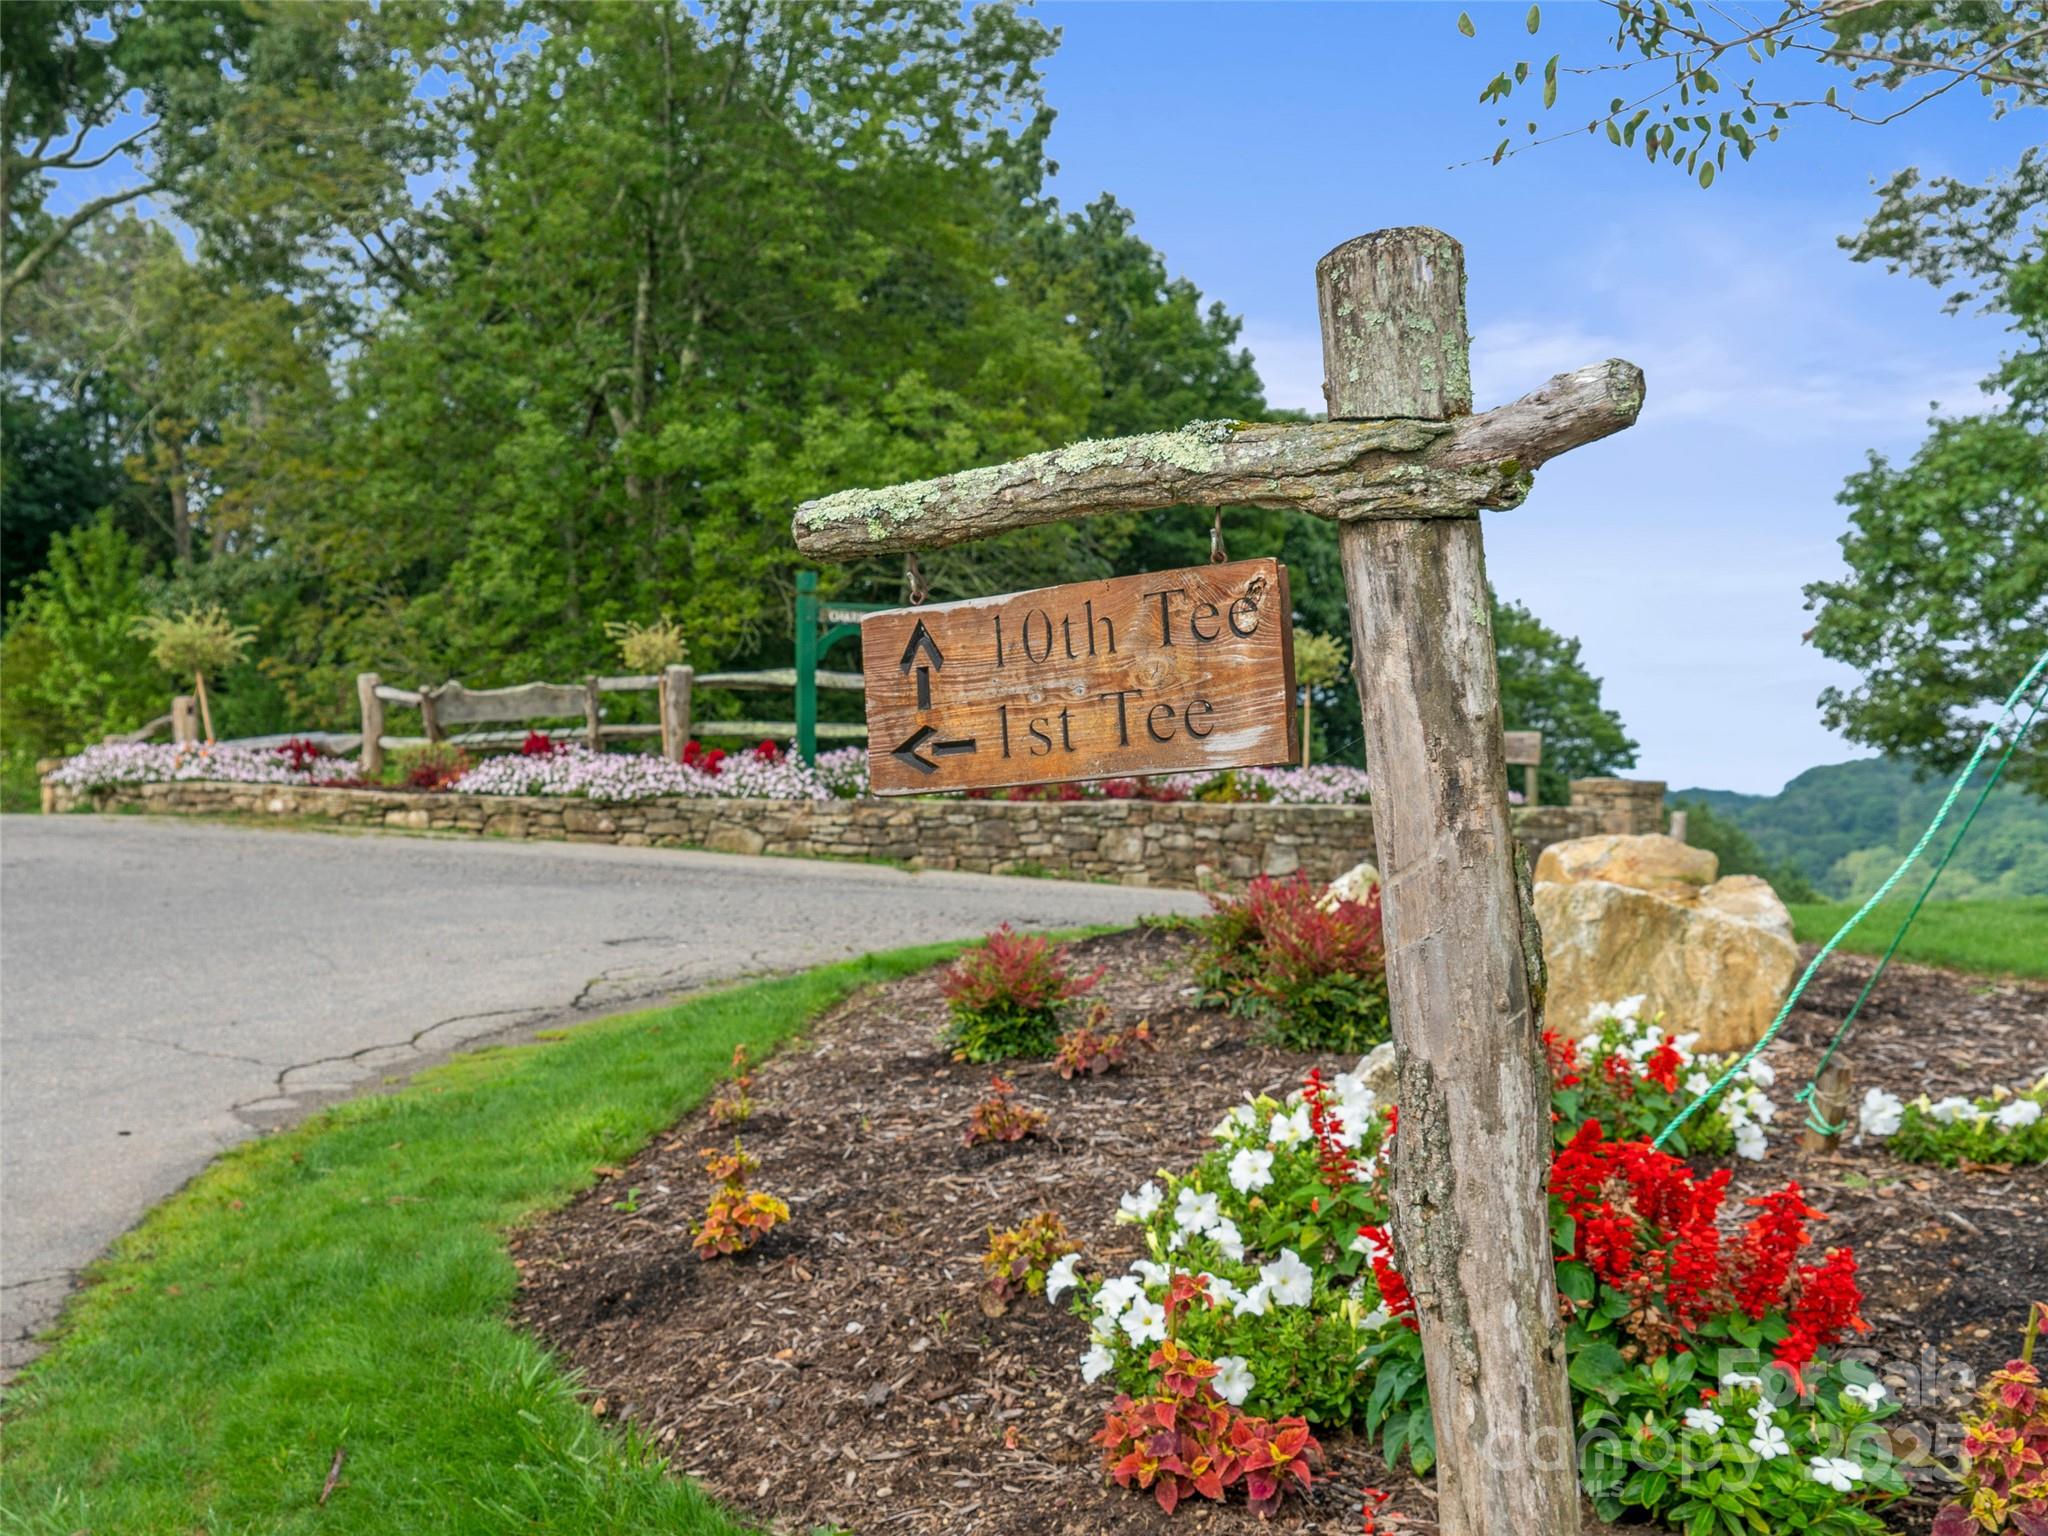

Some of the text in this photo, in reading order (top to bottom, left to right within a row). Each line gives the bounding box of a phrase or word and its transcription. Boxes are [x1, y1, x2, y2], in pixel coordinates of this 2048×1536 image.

[992, 588, 1261, 668] 10th Tee
[997, 688, 1215, 759] 1st Tee
